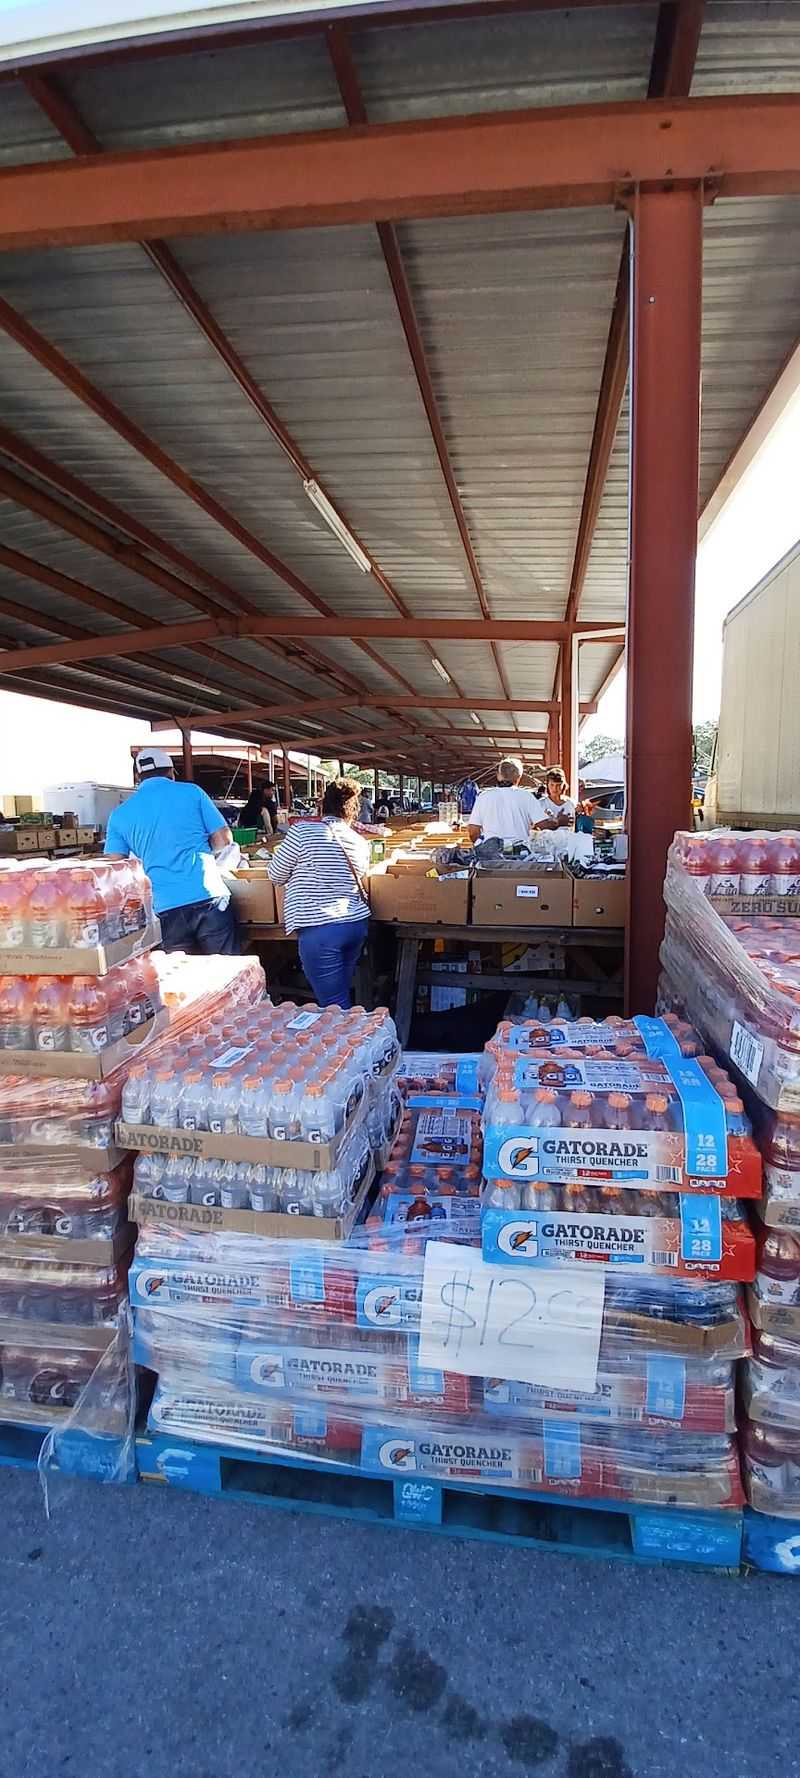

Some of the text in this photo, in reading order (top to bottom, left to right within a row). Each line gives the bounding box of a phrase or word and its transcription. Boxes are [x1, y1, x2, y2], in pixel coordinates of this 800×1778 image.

[731, 902, 800, 913] ZERO SU
[274, 1126, 286, 1140] G
[308, 1130, 321, 1144] G
[696, 1134, 716, 1148] 12
[542, 1139, 648, 1158] GATORADE
[498, 1136, 540, 1178] G
[556, 1155, 639, 1167] THIRST QUENCHER
[695, 1153, 718, 1167] 28
[203, 1191, 216, 1206] G
[287, 1202, 300, 1215] G
[497, 1220, 539, 1258] G
[541, 1223, 645, 1243] GATORADE
[554, 1239, 635, 1251] THIRST QUENCHER
[691, 1239, 712, 1251] 28
[172, 1272, 260, 1288] GATORADE
[288, 1357, 377, 1378] GATORADE
[379, 1440, 417, 1472] G
[419, 1443, 512, 1461] GATORADE
[431, 1456, 503, 1468] THIRST QUENCHER
